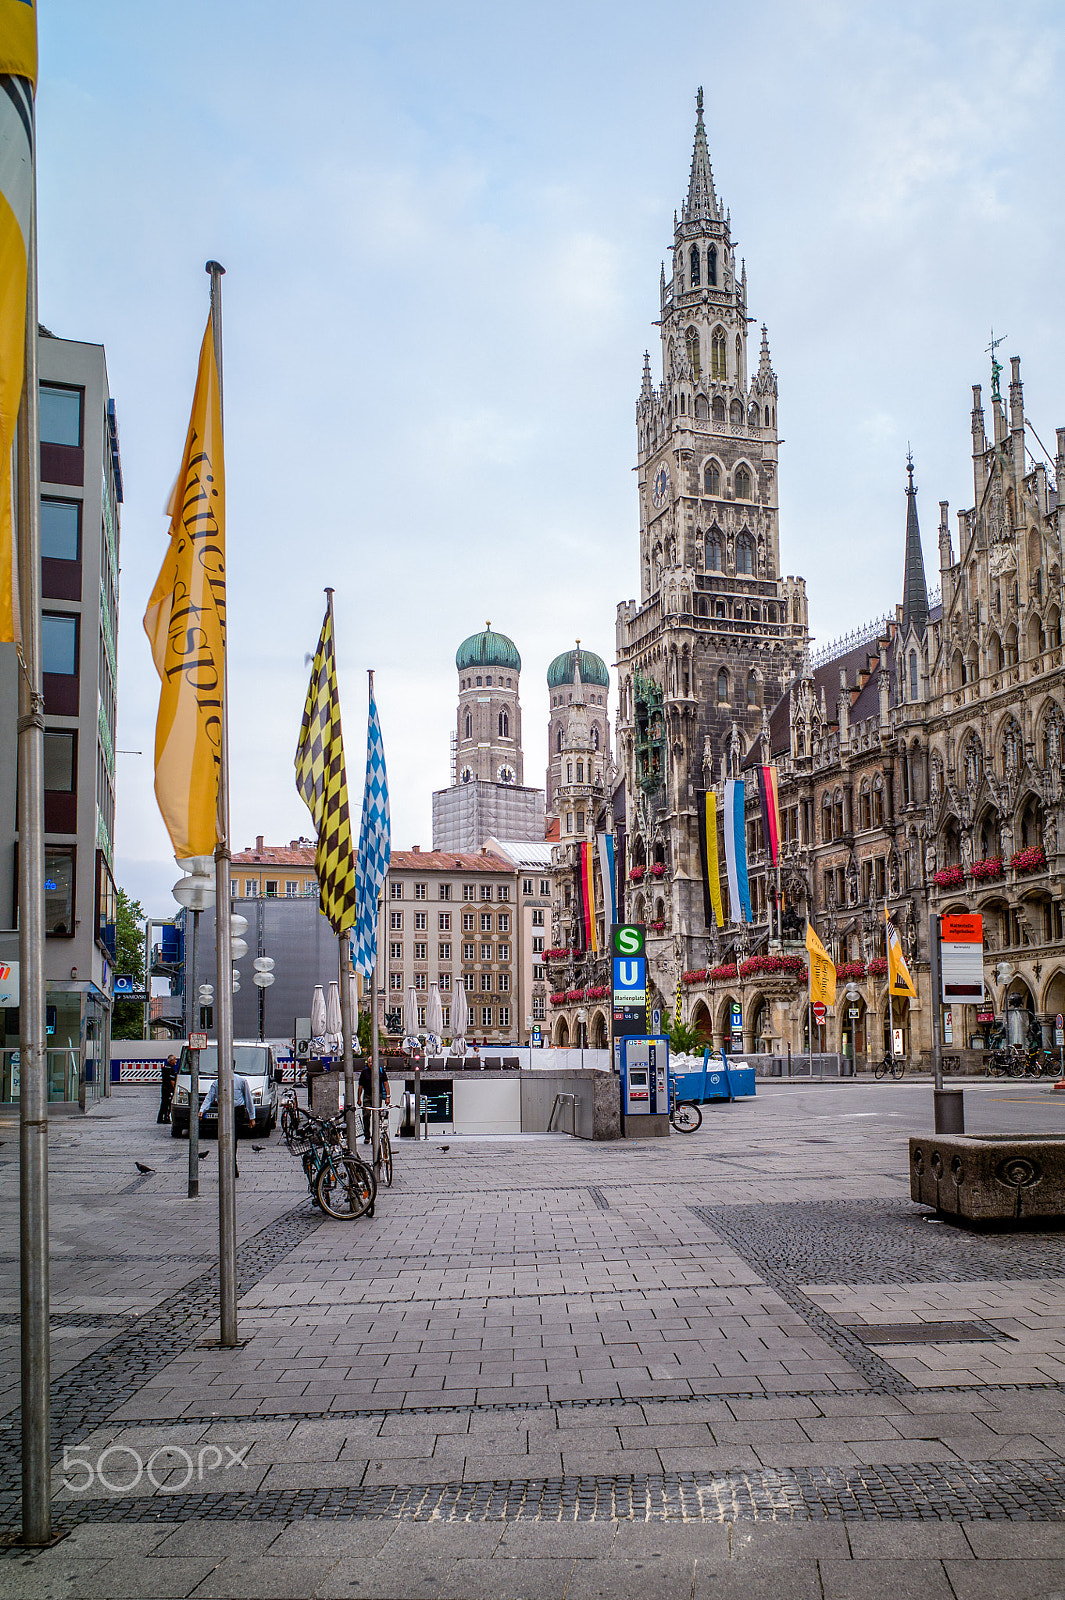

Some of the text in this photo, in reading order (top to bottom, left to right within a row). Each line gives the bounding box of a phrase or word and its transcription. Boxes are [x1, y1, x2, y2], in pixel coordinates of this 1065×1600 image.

[619, 928, 639, 954] S
[619, 961, 639, 986] U
[733, 1004, 741, 1014] S
[733, 1015, 740, 1025] U
